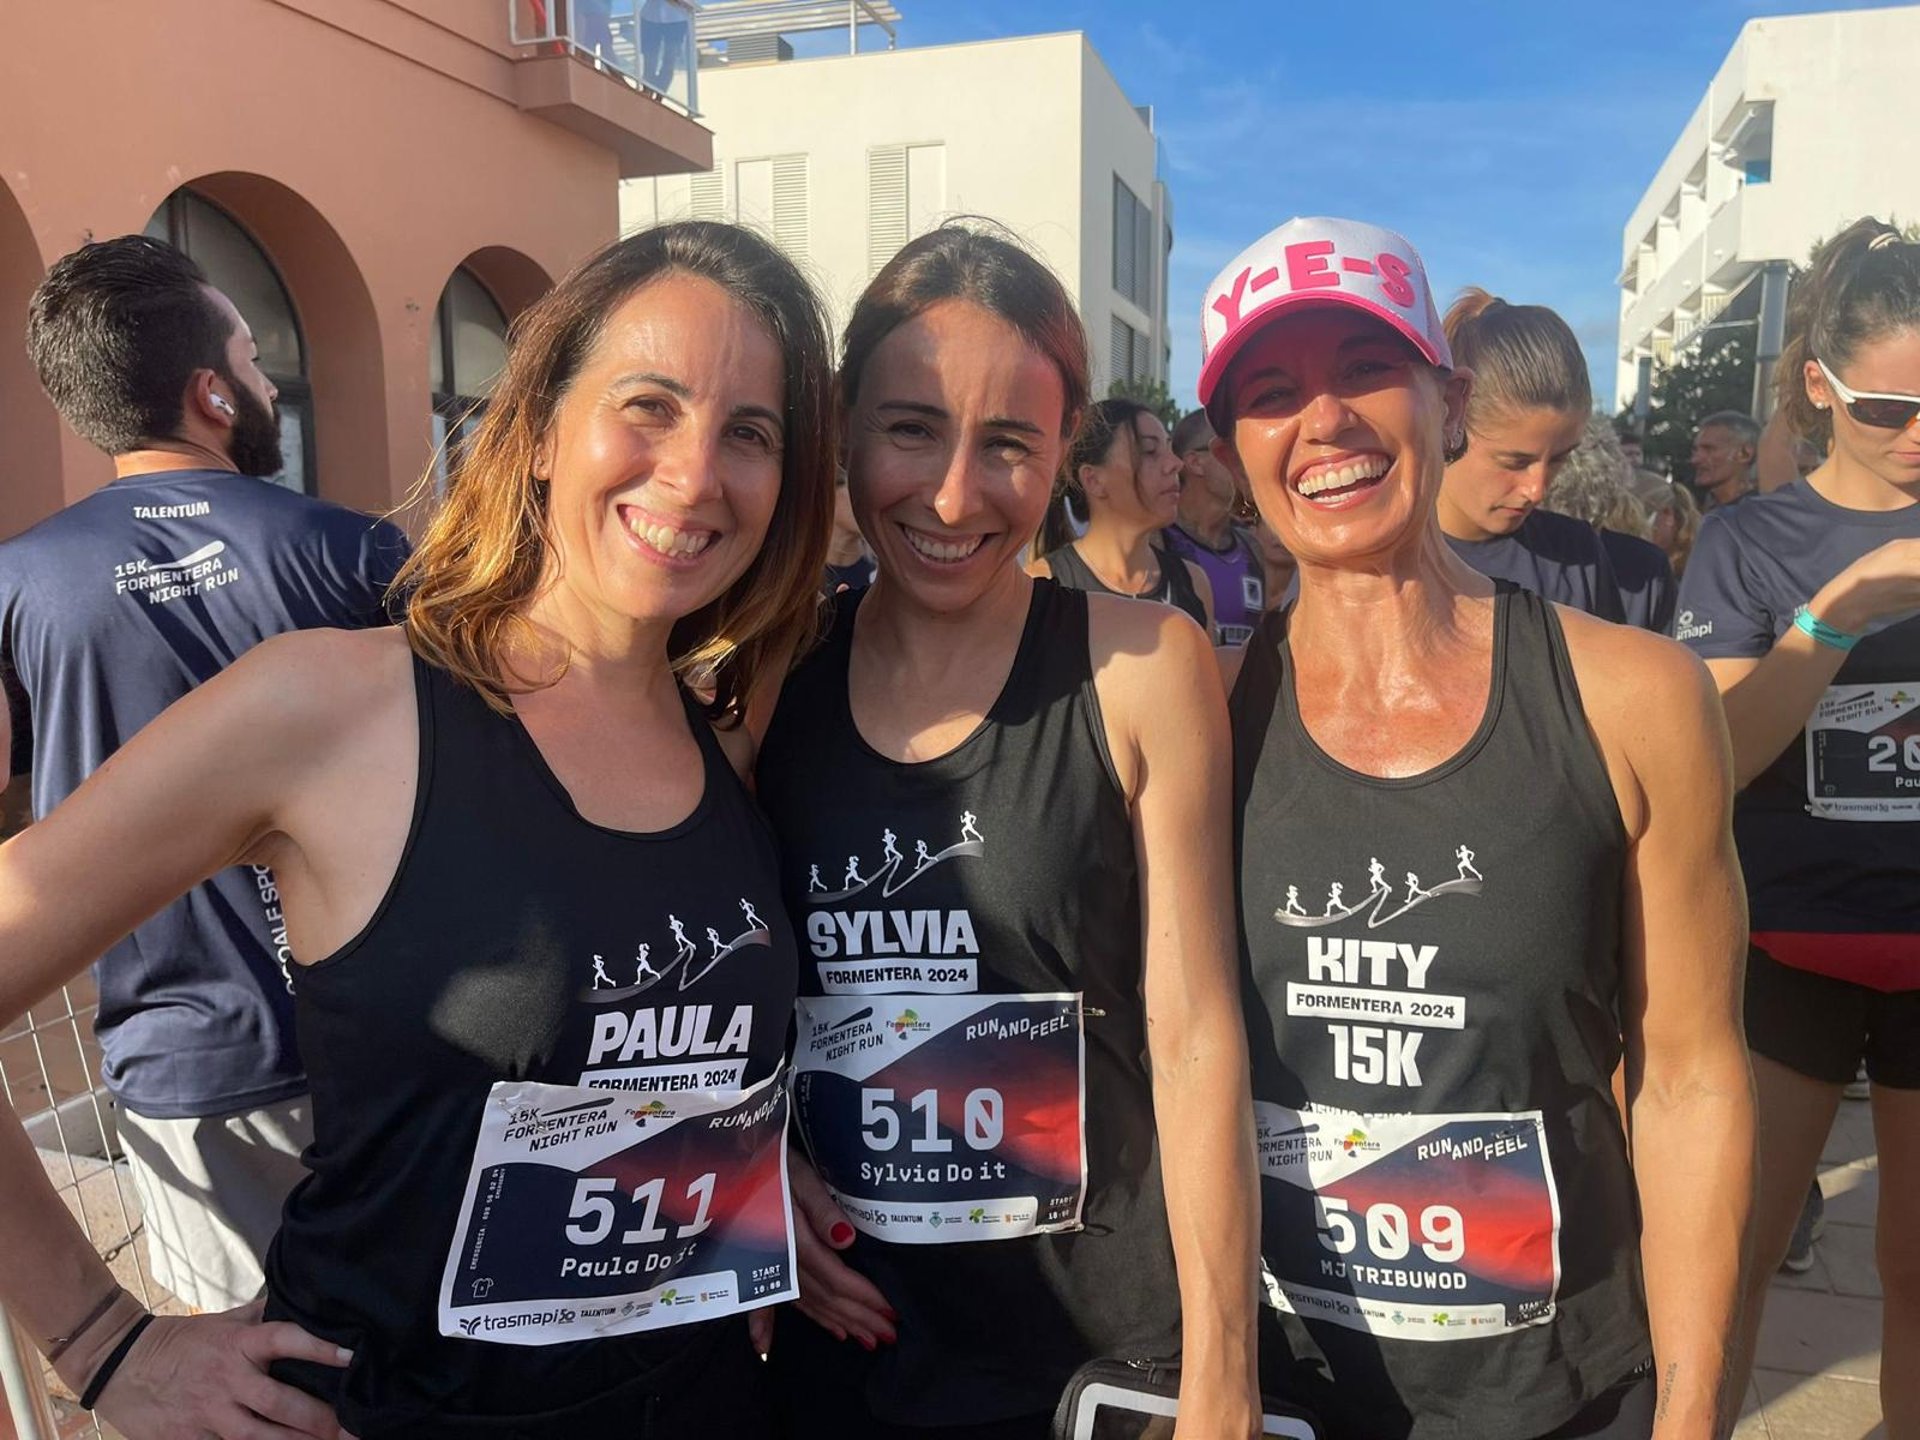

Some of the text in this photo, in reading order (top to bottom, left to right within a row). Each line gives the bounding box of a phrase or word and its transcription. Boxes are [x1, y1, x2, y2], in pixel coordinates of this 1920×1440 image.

[1212, 240, 1416, 332] Y-E-S
[133, 501, 210, 518] TALENTUM
[115, 559, 148, 578] 15K
[116, 558, 222, 595] FORMENTERA
[149, 568, 238, 604] NIGHT RUN
[807, 910, 980, 957] SYLVIA
[827, 967, 969, 984] FORMENTERA 2024
[1307, 936, 1439, 989] KITY
[1296, 993, 1455, 1019] FORMENTERA 2024
[587, 1004, 753, 1065] PAULA
[810, 1022, 873, 1052] FORMENTERA
[812, 1022, 830, 1037] 15K
[826, 1034, 883, 1061] NIGHT RUN
[1327, 1024, 1423, 1087] 15K
[589, 1068, 737, 1092] FORMENTERA 2024
[504, 1110, 607, 1142] FORMENTERA
[509, 1108, 541, 1126] 15K
[861, 1087, 1004, 1153] 510
[529, 1120, 618, 1152] NIGHT RUN
[1257, 1127, 1271, 1139] 5K
[1268, 1150, 1332, 1167] NIGHT RUN
[861, 1162, 1005, 1187] Sylvia Do it
[565, 1173, 716, 1245] 511
[891, 1214, 923, 1223] TALENTUM
[1314, 1195, 1465, 1262] 509
[561, 1257, 639, 1277] Paula
[645, 1254, 671, 1272] Do
[752, 1264, 780, 1278] START
[1321, 1259, 1467, 1290] MJ TRIBUWOD
[484, 1309, 558, 1330] trasmapi
[581, 1308, 616, 1318] TALENTUM
